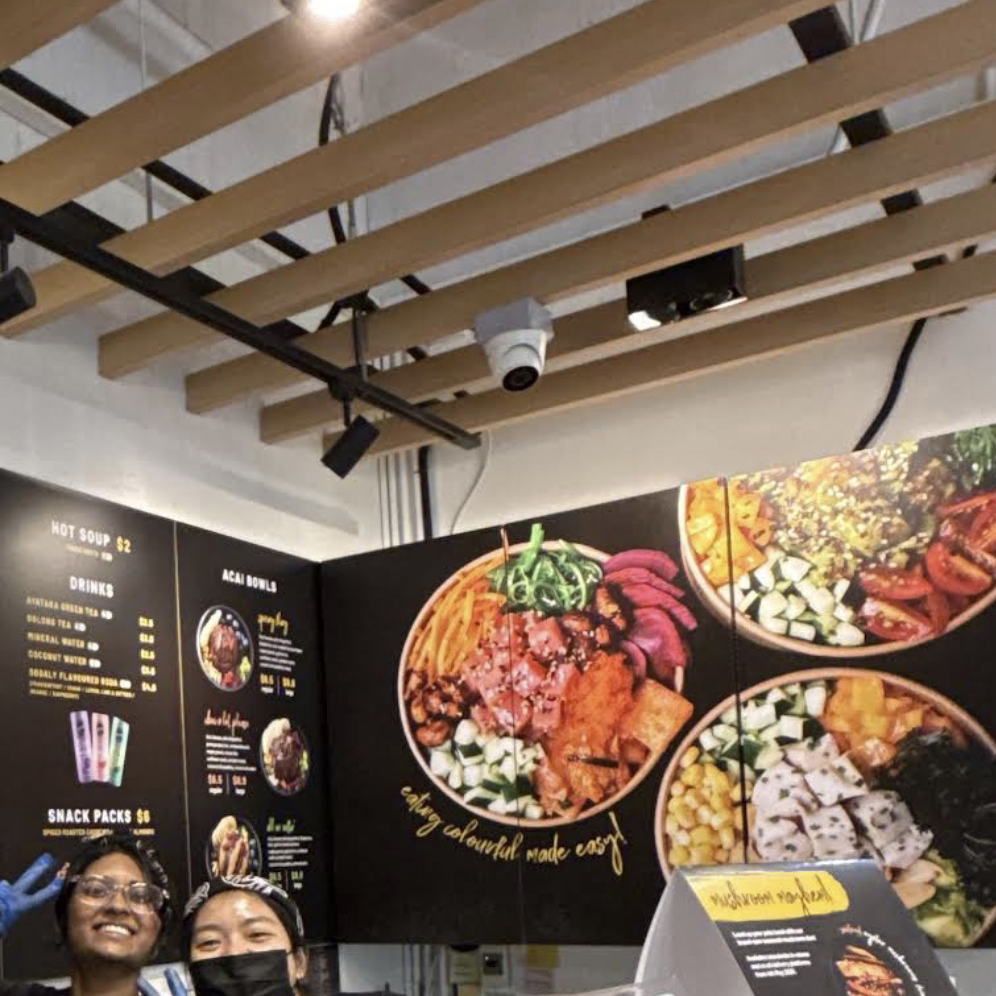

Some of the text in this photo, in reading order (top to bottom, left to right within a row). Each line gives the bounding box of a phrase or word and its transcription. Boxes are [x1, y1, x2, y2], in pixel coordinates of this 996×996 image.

[52, 520, 75, 539] HOT
[79, 527, 110, 547] SOUP
[117, 536, 131, 553] $2
[70, 575, 114, 598] DRINKS
[222, 569, 277, 593] ACAI BOWLS
[85, 606, 99, 617] TEA
[57, 619, 71, 629] TEA
[62, 637, 85, 649] WATER
[28, 649, 87, 666] COCONUT WATER
[48, 808, 90, 823] SNACK
[93, 808, 132, 824] PACKS
[401, 786, 628, 876] eating colourful made easy!
